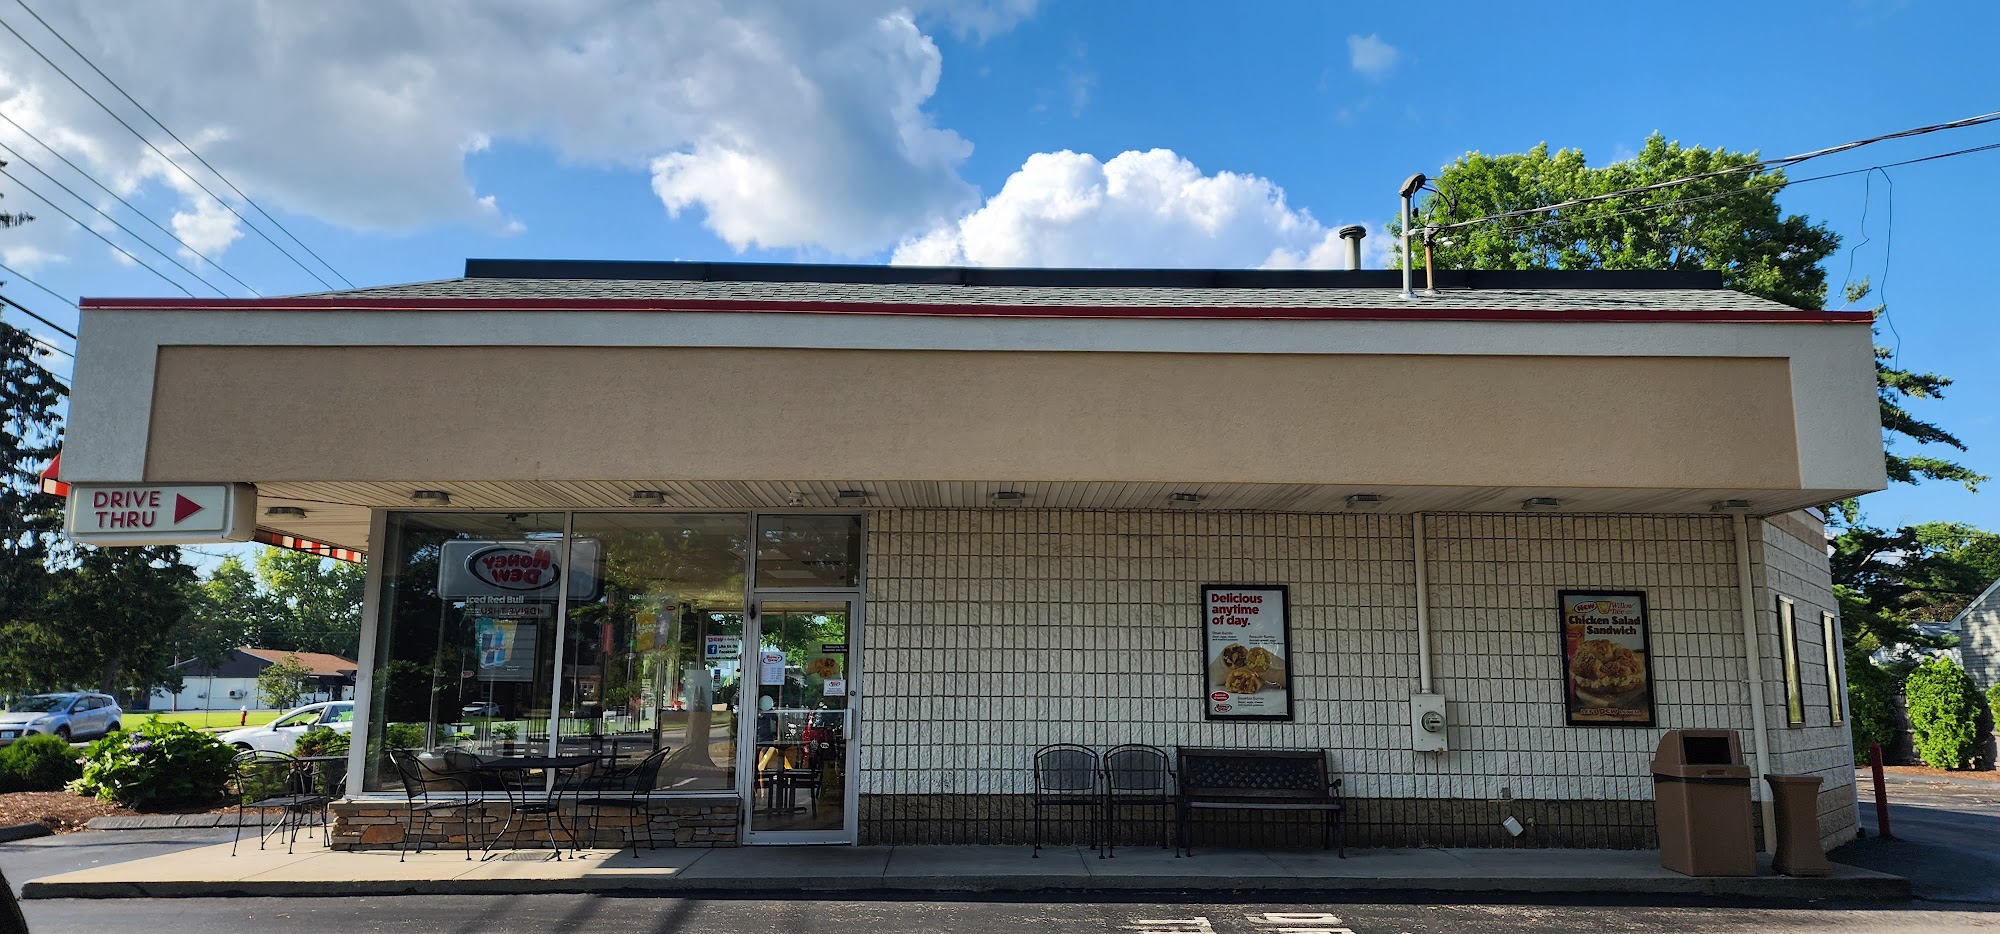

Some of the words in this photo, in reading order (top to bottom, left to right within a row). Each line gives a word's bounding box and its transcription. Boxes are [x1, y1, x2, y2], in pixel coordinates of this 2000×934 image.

[94, 491, 161, 507] DRIVE
[95, 511, 156, 528] THRU
[466, 595, 486, 604] Iced
[488, 595, 505, 604] Red
[507, 595, 525, 604] Bull
[1211, 593, 1263, 604] Delicious
[1211, 604, 1260, 616] anytime
[1212, 616, 1225, 625] of
[1227, 616, 1251, 627] day.
[1568, 615, 1610, 625] Chicken
[1611, 616, 1641, 625] Salad
[1586, 625, 1637, 635] Sandwich
